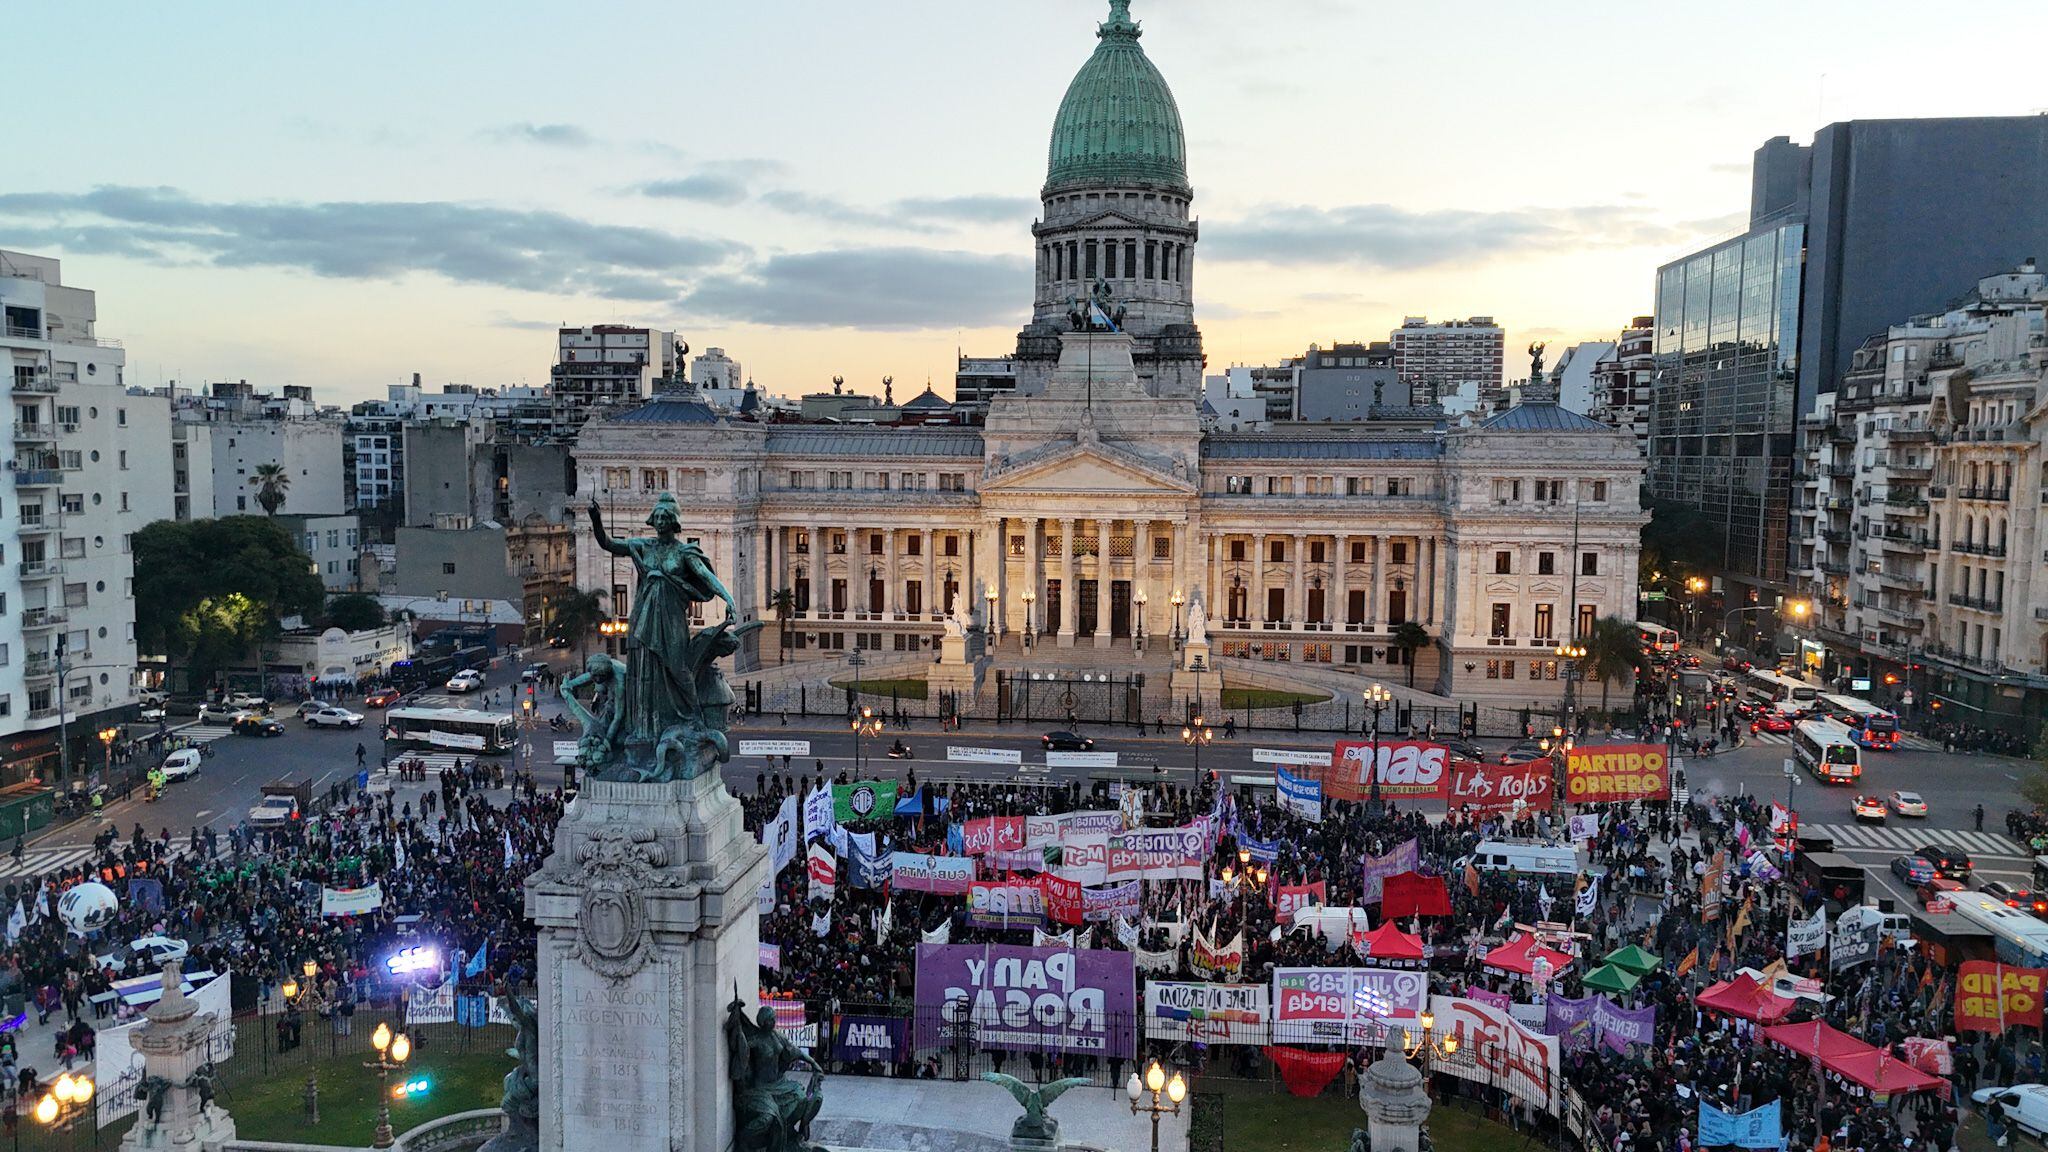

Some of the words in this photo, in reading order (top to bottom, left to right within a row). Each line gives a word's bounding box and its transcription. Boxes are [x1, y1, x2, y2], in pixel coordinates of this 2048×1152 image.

[1568, 752, 1664, 774] PARTIDO
[1569, 774, 1664, 794] OBRERO
[567, 1010, 664, 1027] ARGENTINA
